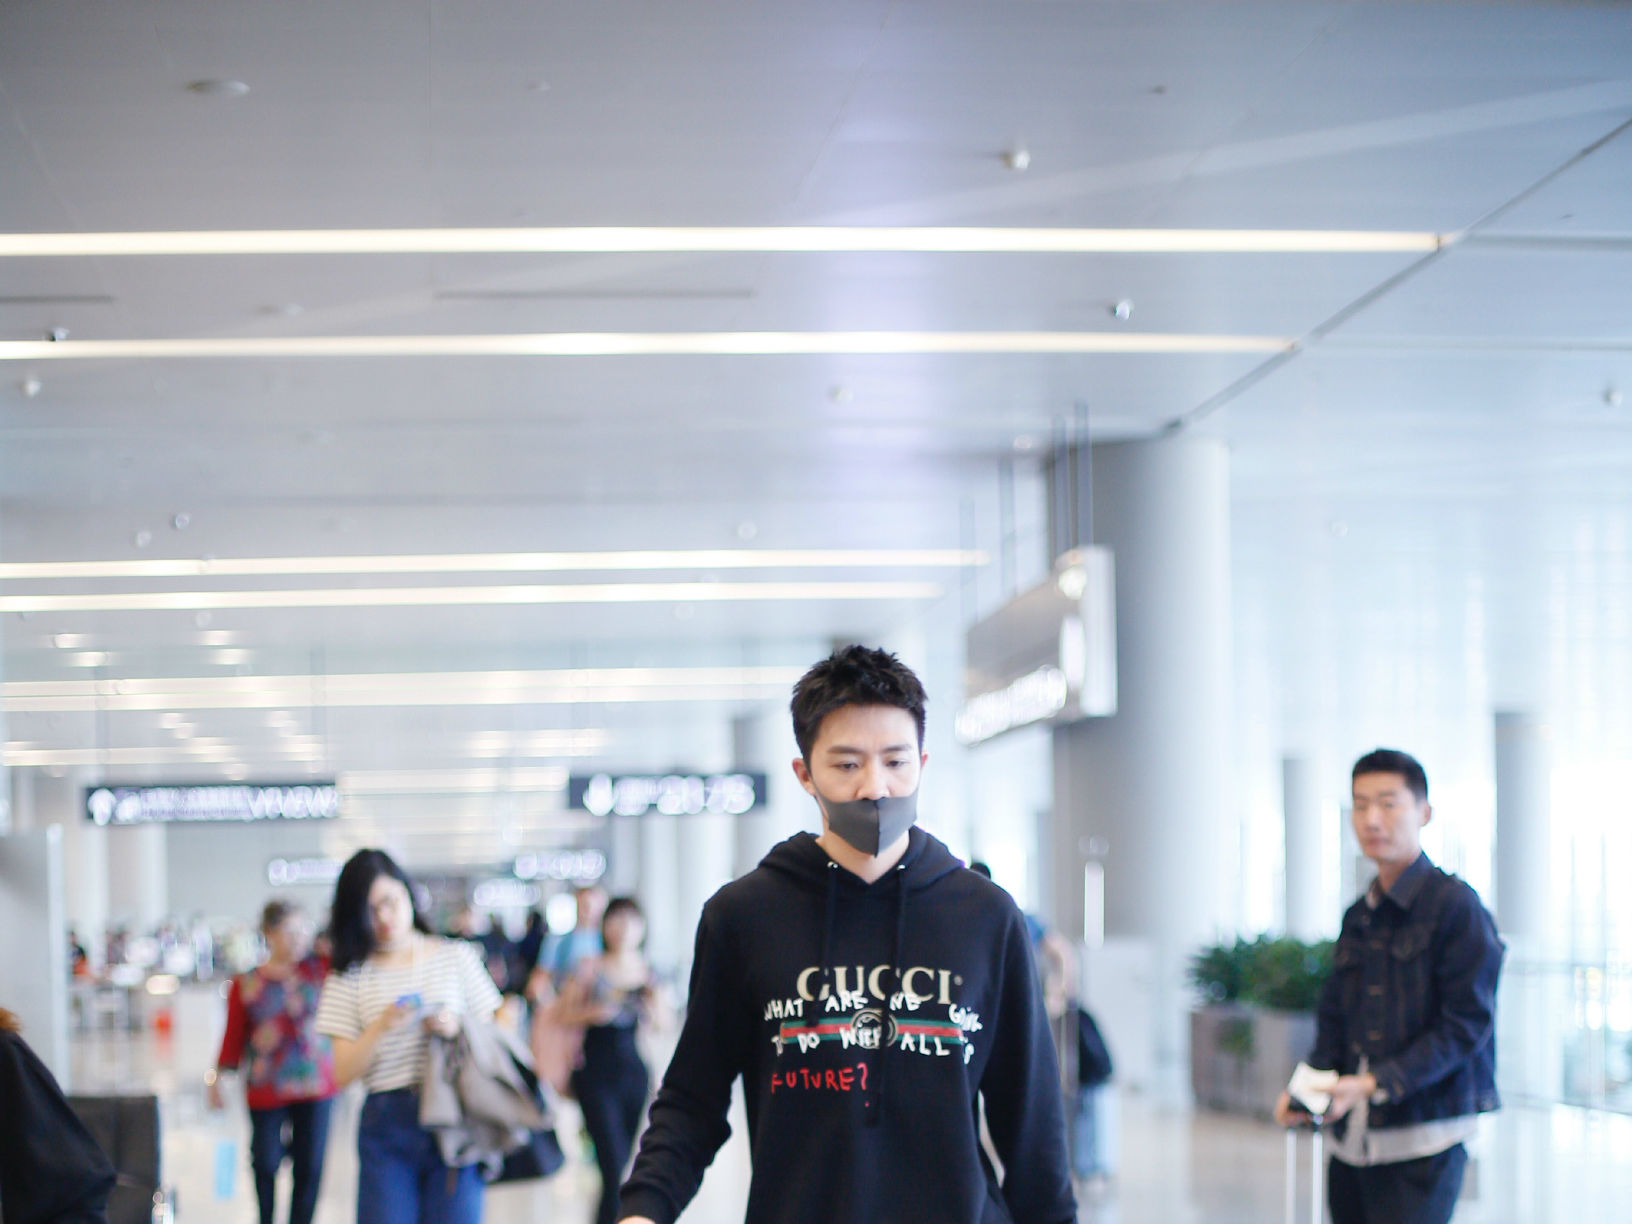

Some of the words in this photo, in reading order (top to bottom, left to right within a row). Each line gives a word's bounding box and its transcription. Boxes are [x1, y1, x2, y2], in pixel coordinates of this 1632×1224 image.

[796, 965, 952, 1004] GUCCI
[825, 990, 868, 1012] ARE
[797, 1031, 820, 1054] DO
[900, 1031, 950, 1056] ALL
